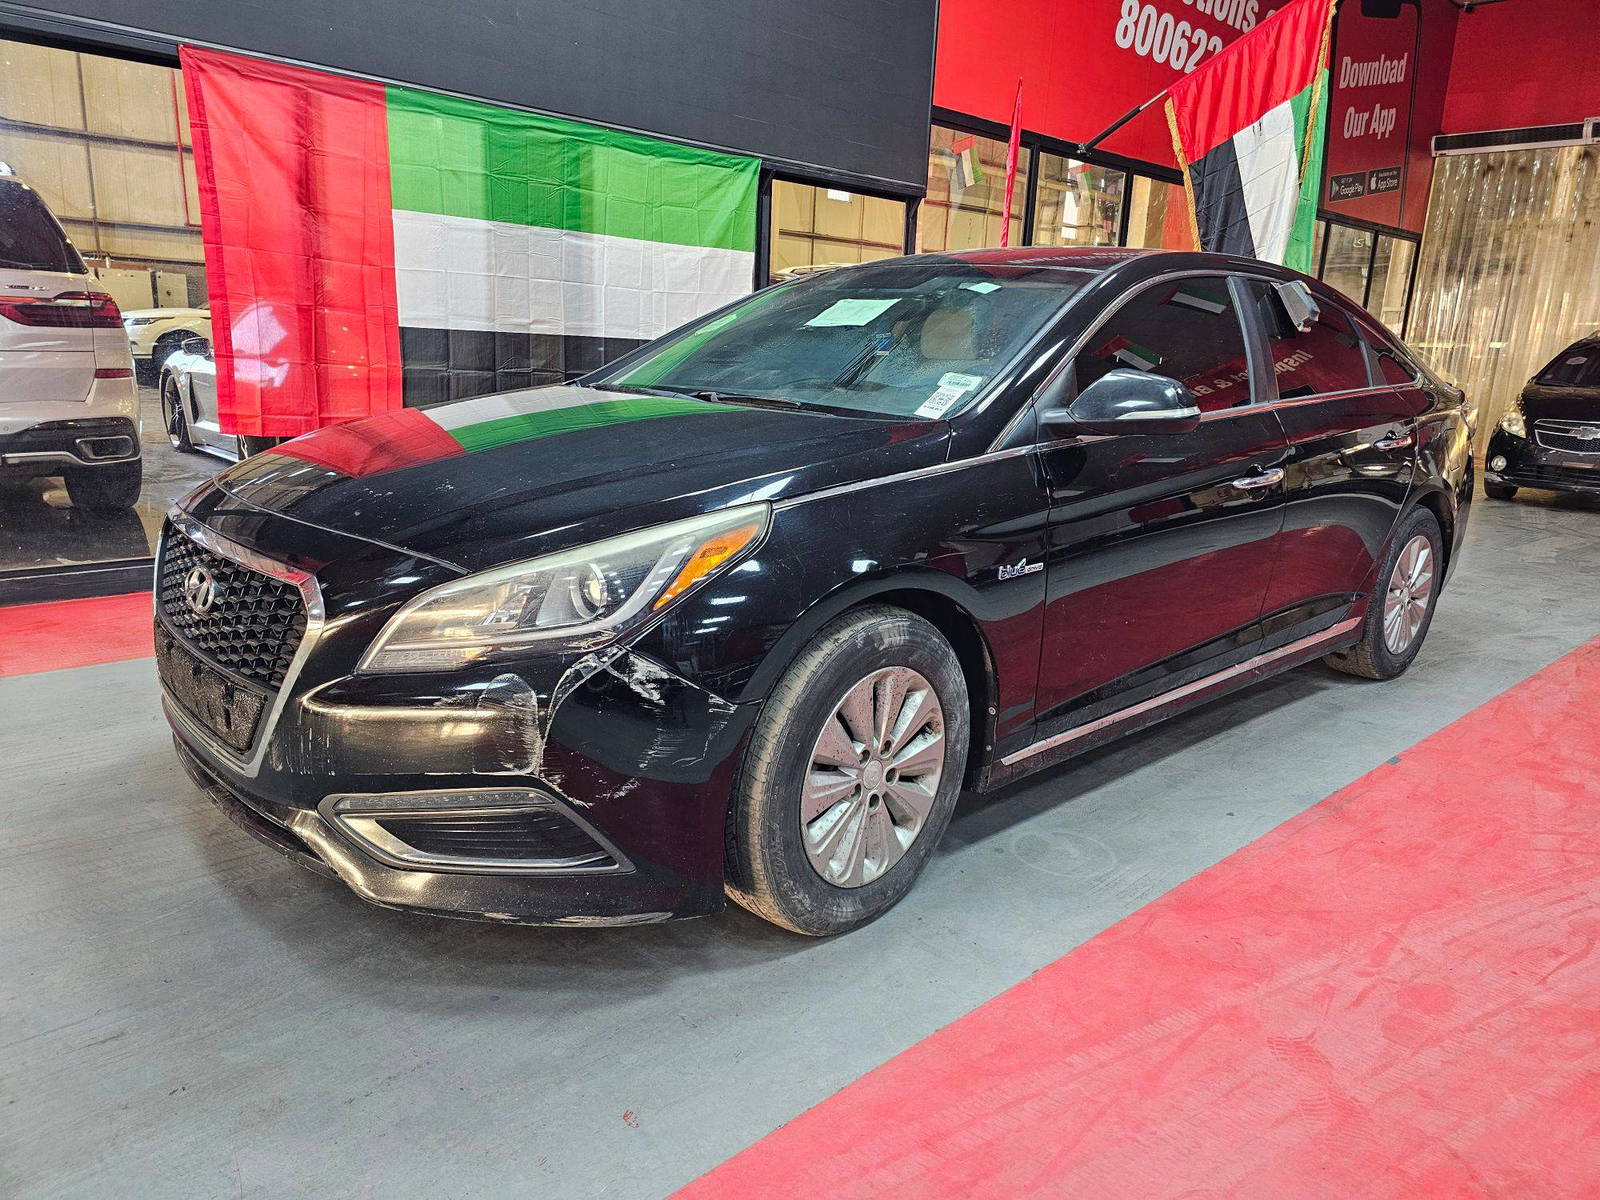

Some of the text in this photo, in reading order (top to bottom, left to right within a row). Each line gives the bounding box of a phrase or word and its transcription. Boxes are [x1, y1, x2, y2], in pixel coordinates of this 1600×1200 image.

[1339, 52, 1408, 89] Download
[1343, 103, 1397, 140] Our App
